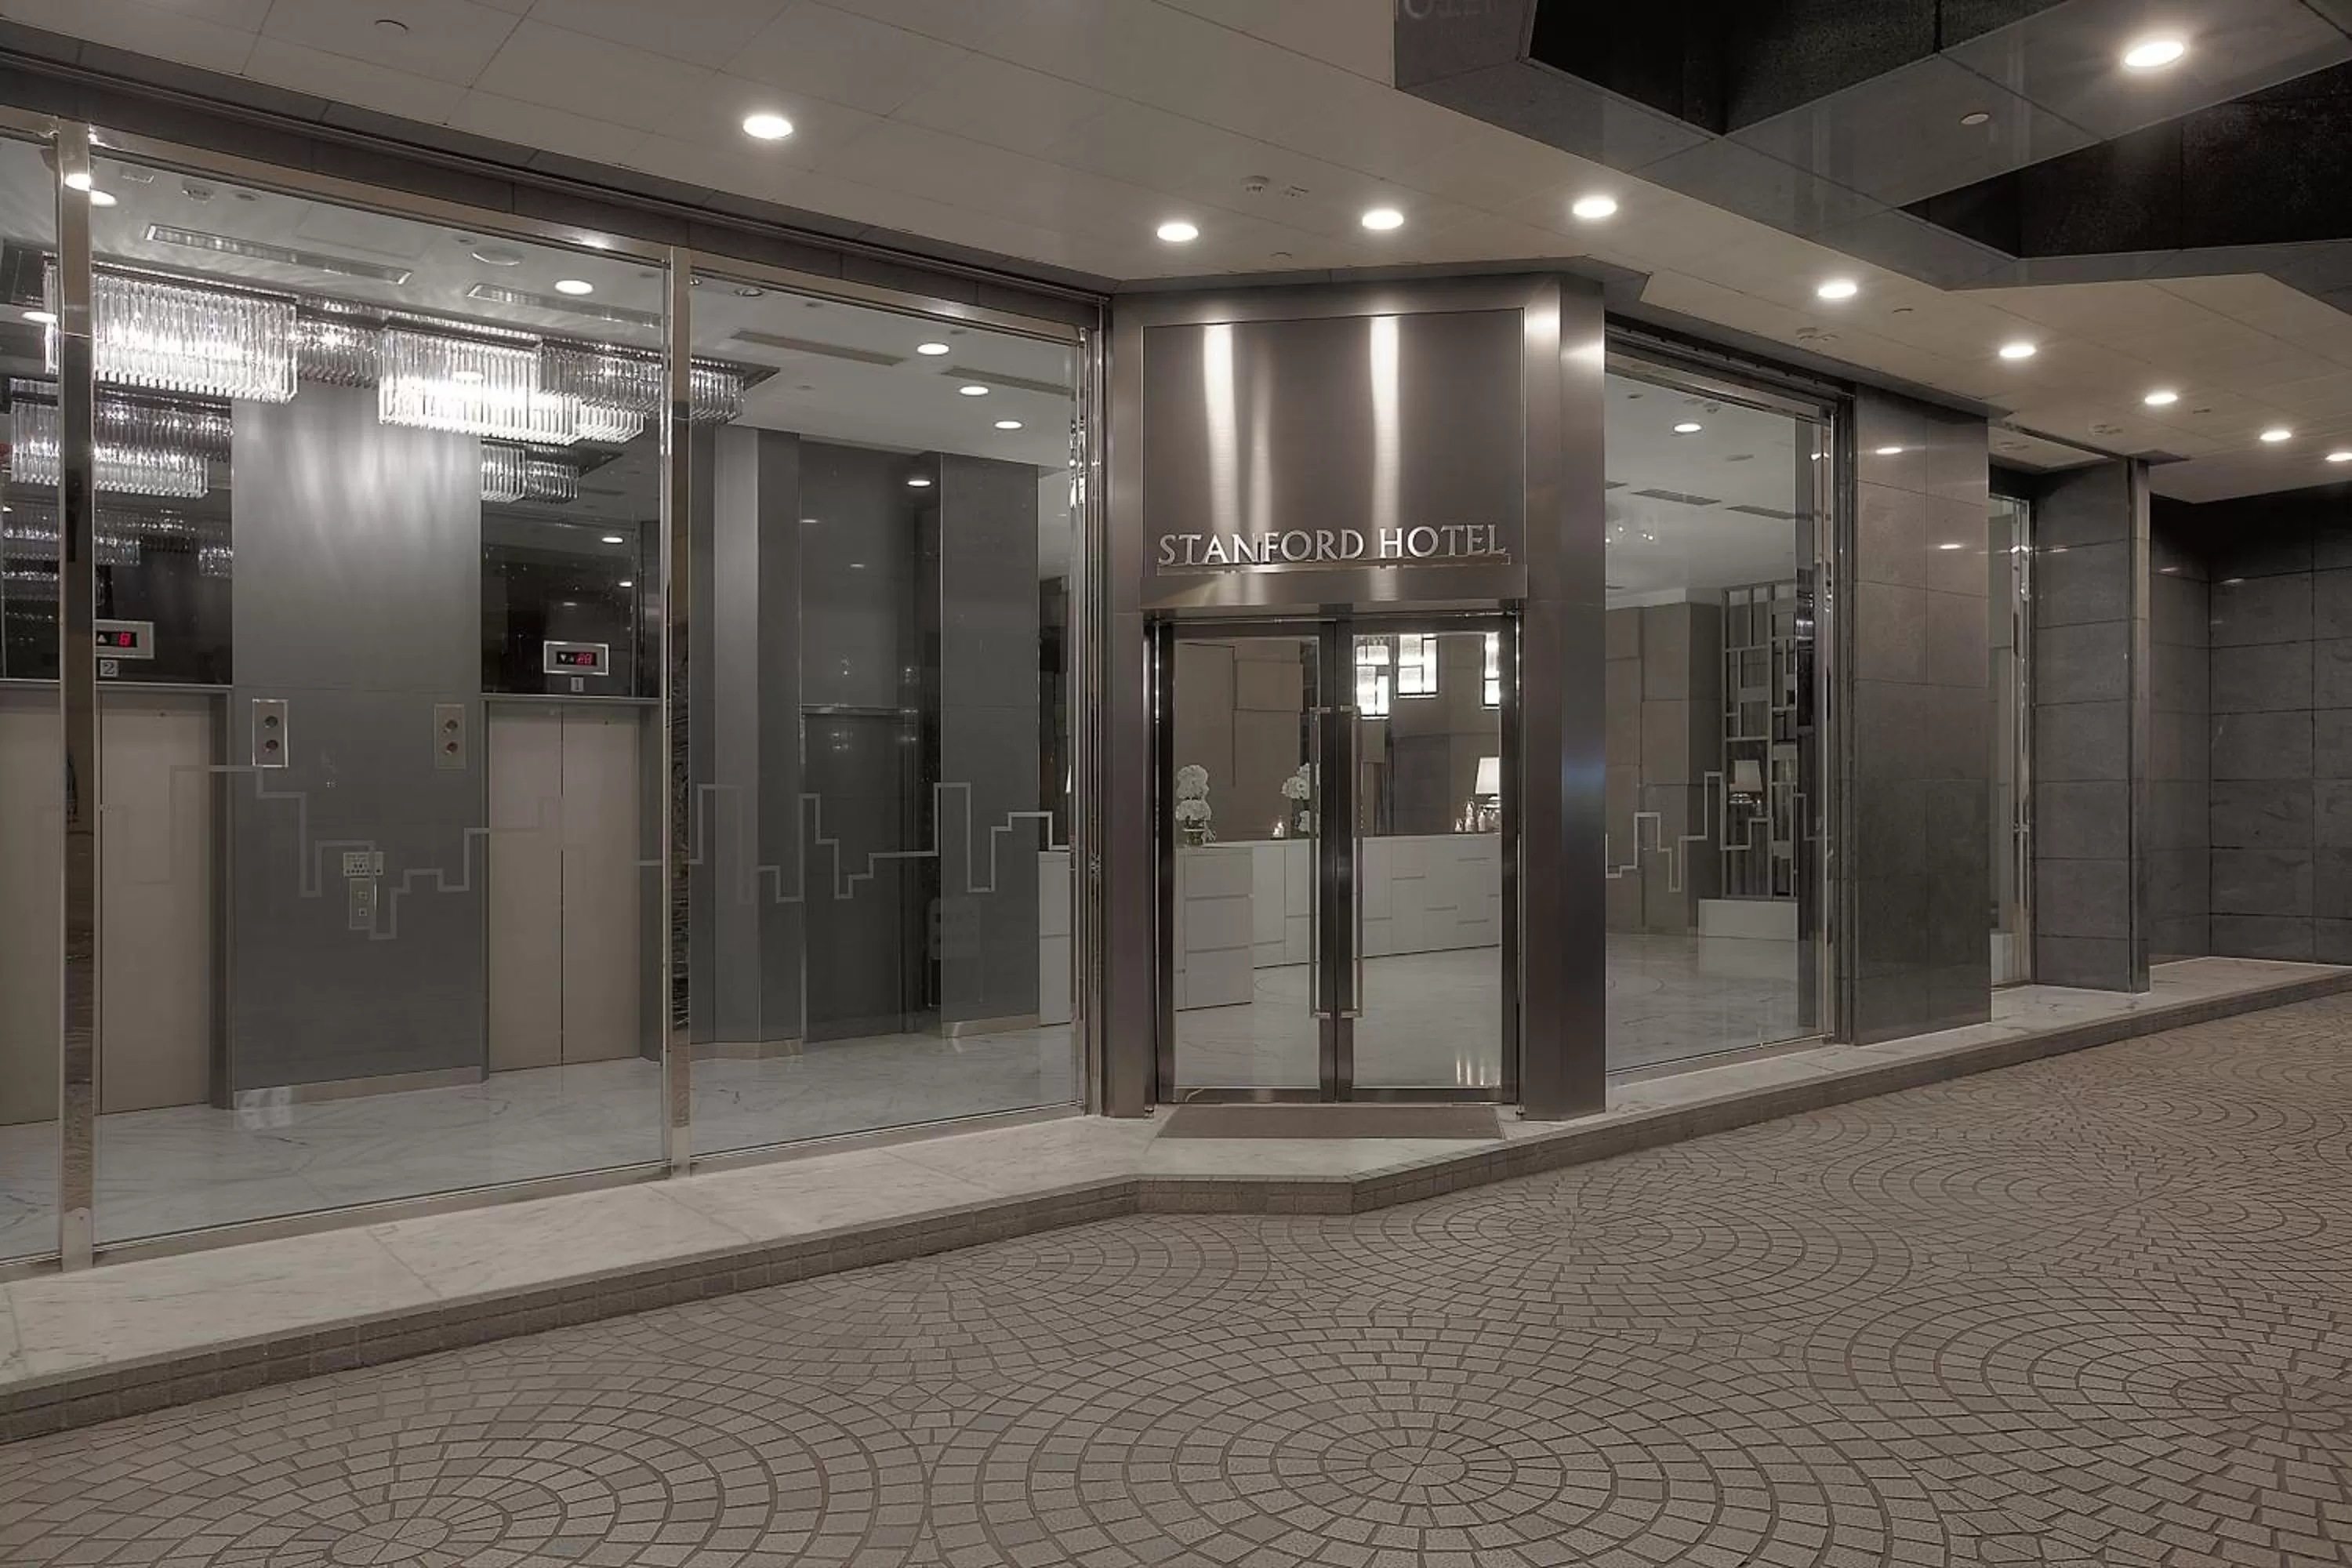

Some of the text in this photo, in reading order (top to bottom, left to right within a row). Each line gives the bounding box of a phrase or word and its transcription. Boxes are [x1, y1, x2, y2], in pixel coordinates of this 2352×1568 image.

[1158, 524, 1507, 564] STANFORD HOTEL
[103, 660, 115, 675] 2
